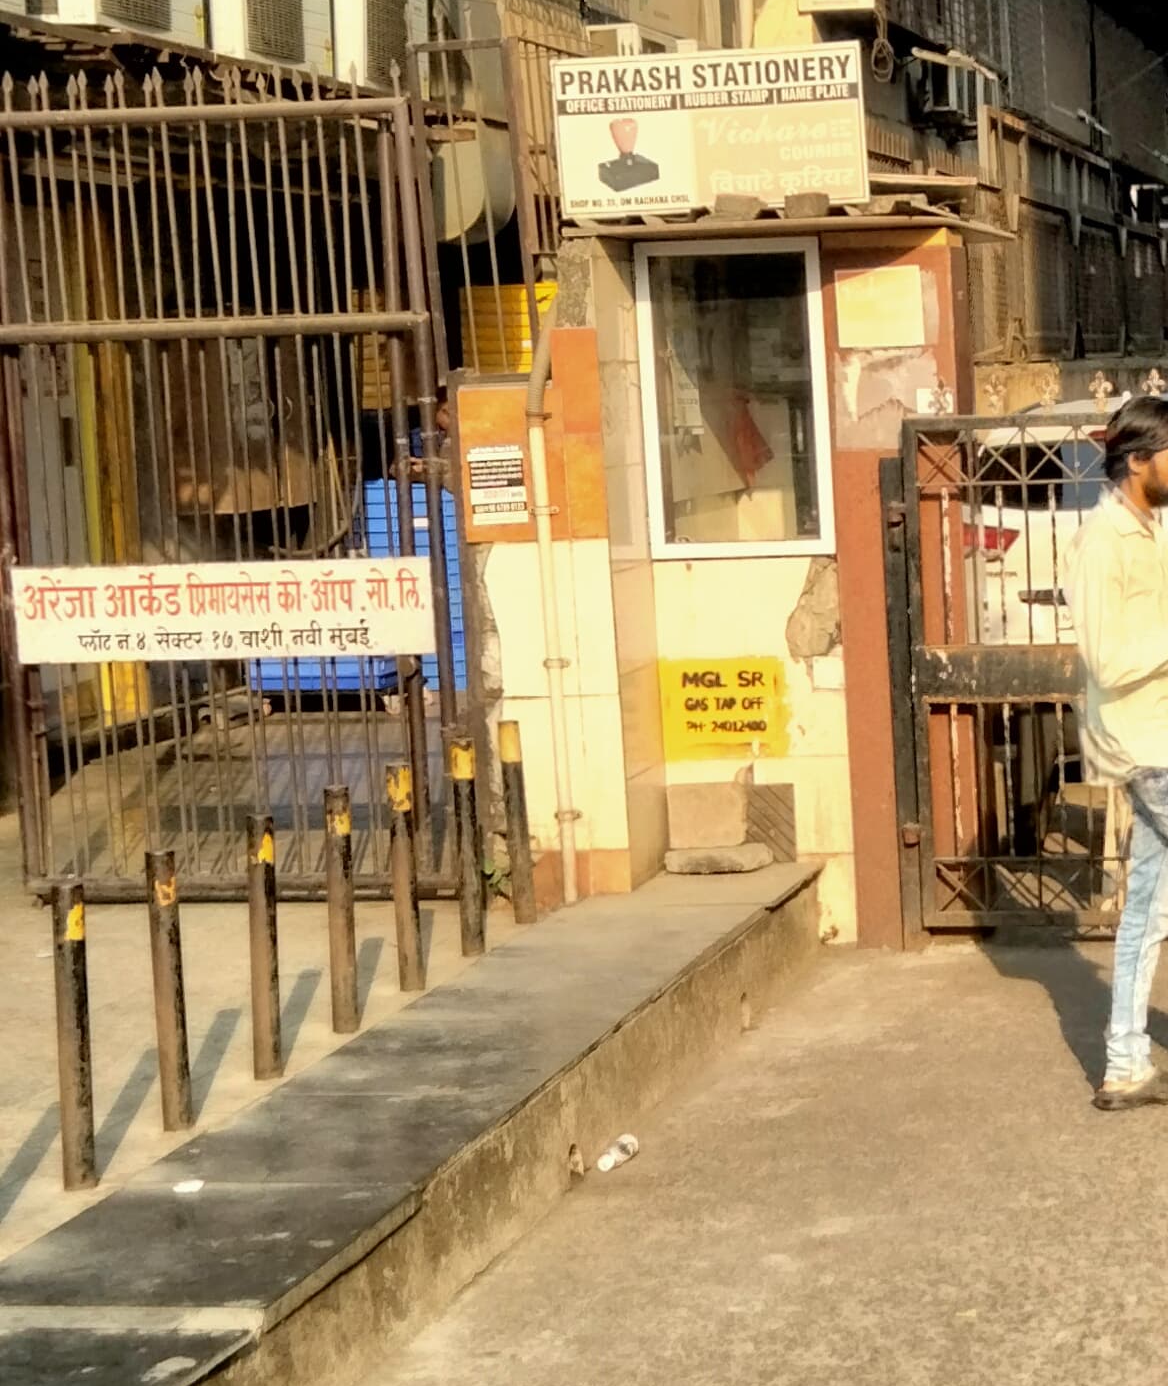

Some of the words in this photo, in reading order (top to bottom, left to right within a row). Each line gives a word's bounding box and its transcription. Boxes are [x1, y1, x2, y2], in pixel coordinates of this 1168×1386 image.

[560, 65, 682, 95] PRAKASH
[692, 54, 852, 88] STATIONERY
[566, 97, 606, 114] OFFICE
[607, 93, 672, 112] STATIONERY
[684, 91, 729, 108] RUBBER
[731, 89, 769, 106] STAMP
[780, 85, 814, 102] NAME
[815, 83, 850, 99] PLATE
[779, 142, 855, 162] COURIER
[24, 576, 97, 621] अरेंजा
[104, 573, 181, 617] आर्केड
[77, 628, 112, 651] प्लॉट
[153, 626, 203, 652] सेक्टर
[290, 619, 323, 646] नवी
[681, 670, 728, 688] MGL
[737, 670, 765, 688] SR
[684, 696, 709, 712] GAS
[713, 696, 737, 711] TAP
